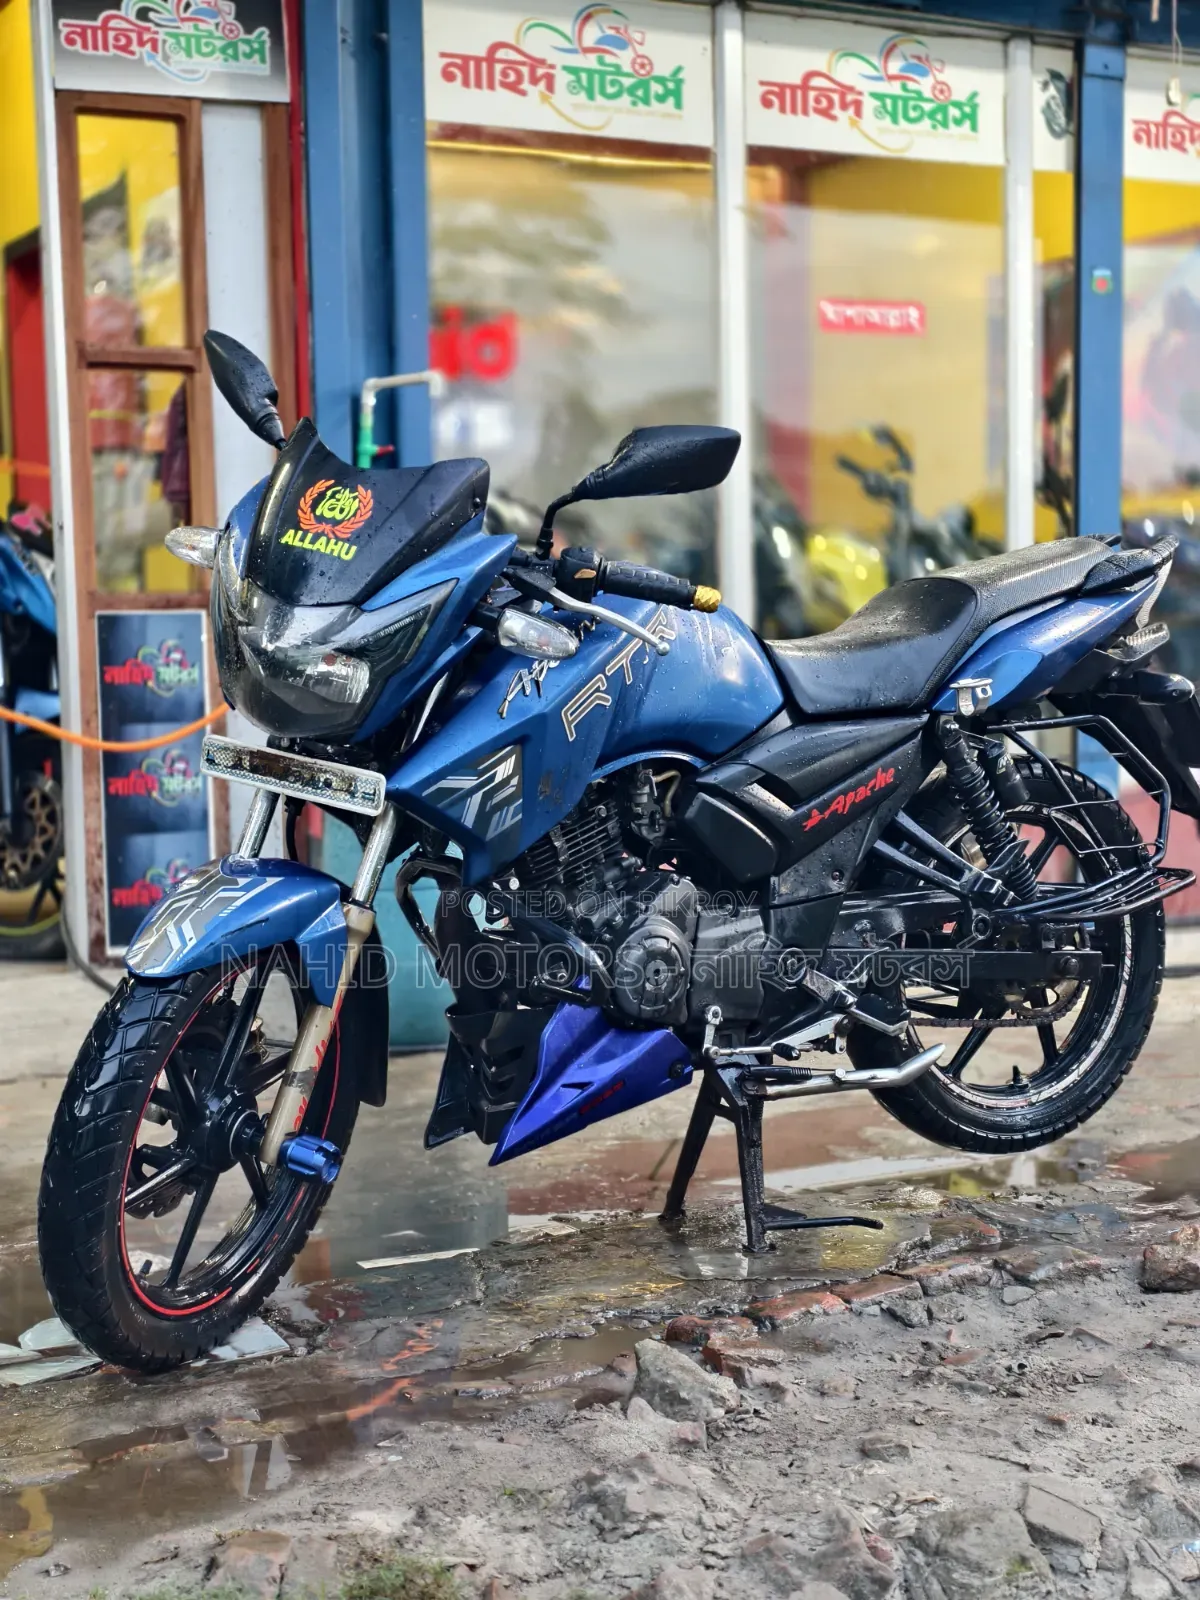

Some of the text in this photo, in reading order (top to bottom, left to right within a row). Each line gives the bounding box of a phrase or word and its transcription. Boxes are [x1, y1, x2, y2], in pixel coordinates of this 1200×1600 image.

[61, 14, 159, 57] নাহিদ
[439, 41, 557, 97] নাহিদ
[758, 70, 864, 122] নাহিদ
[280, 529, 357, 561] ALLAHU
[824, 767, 895, 820] Apache
